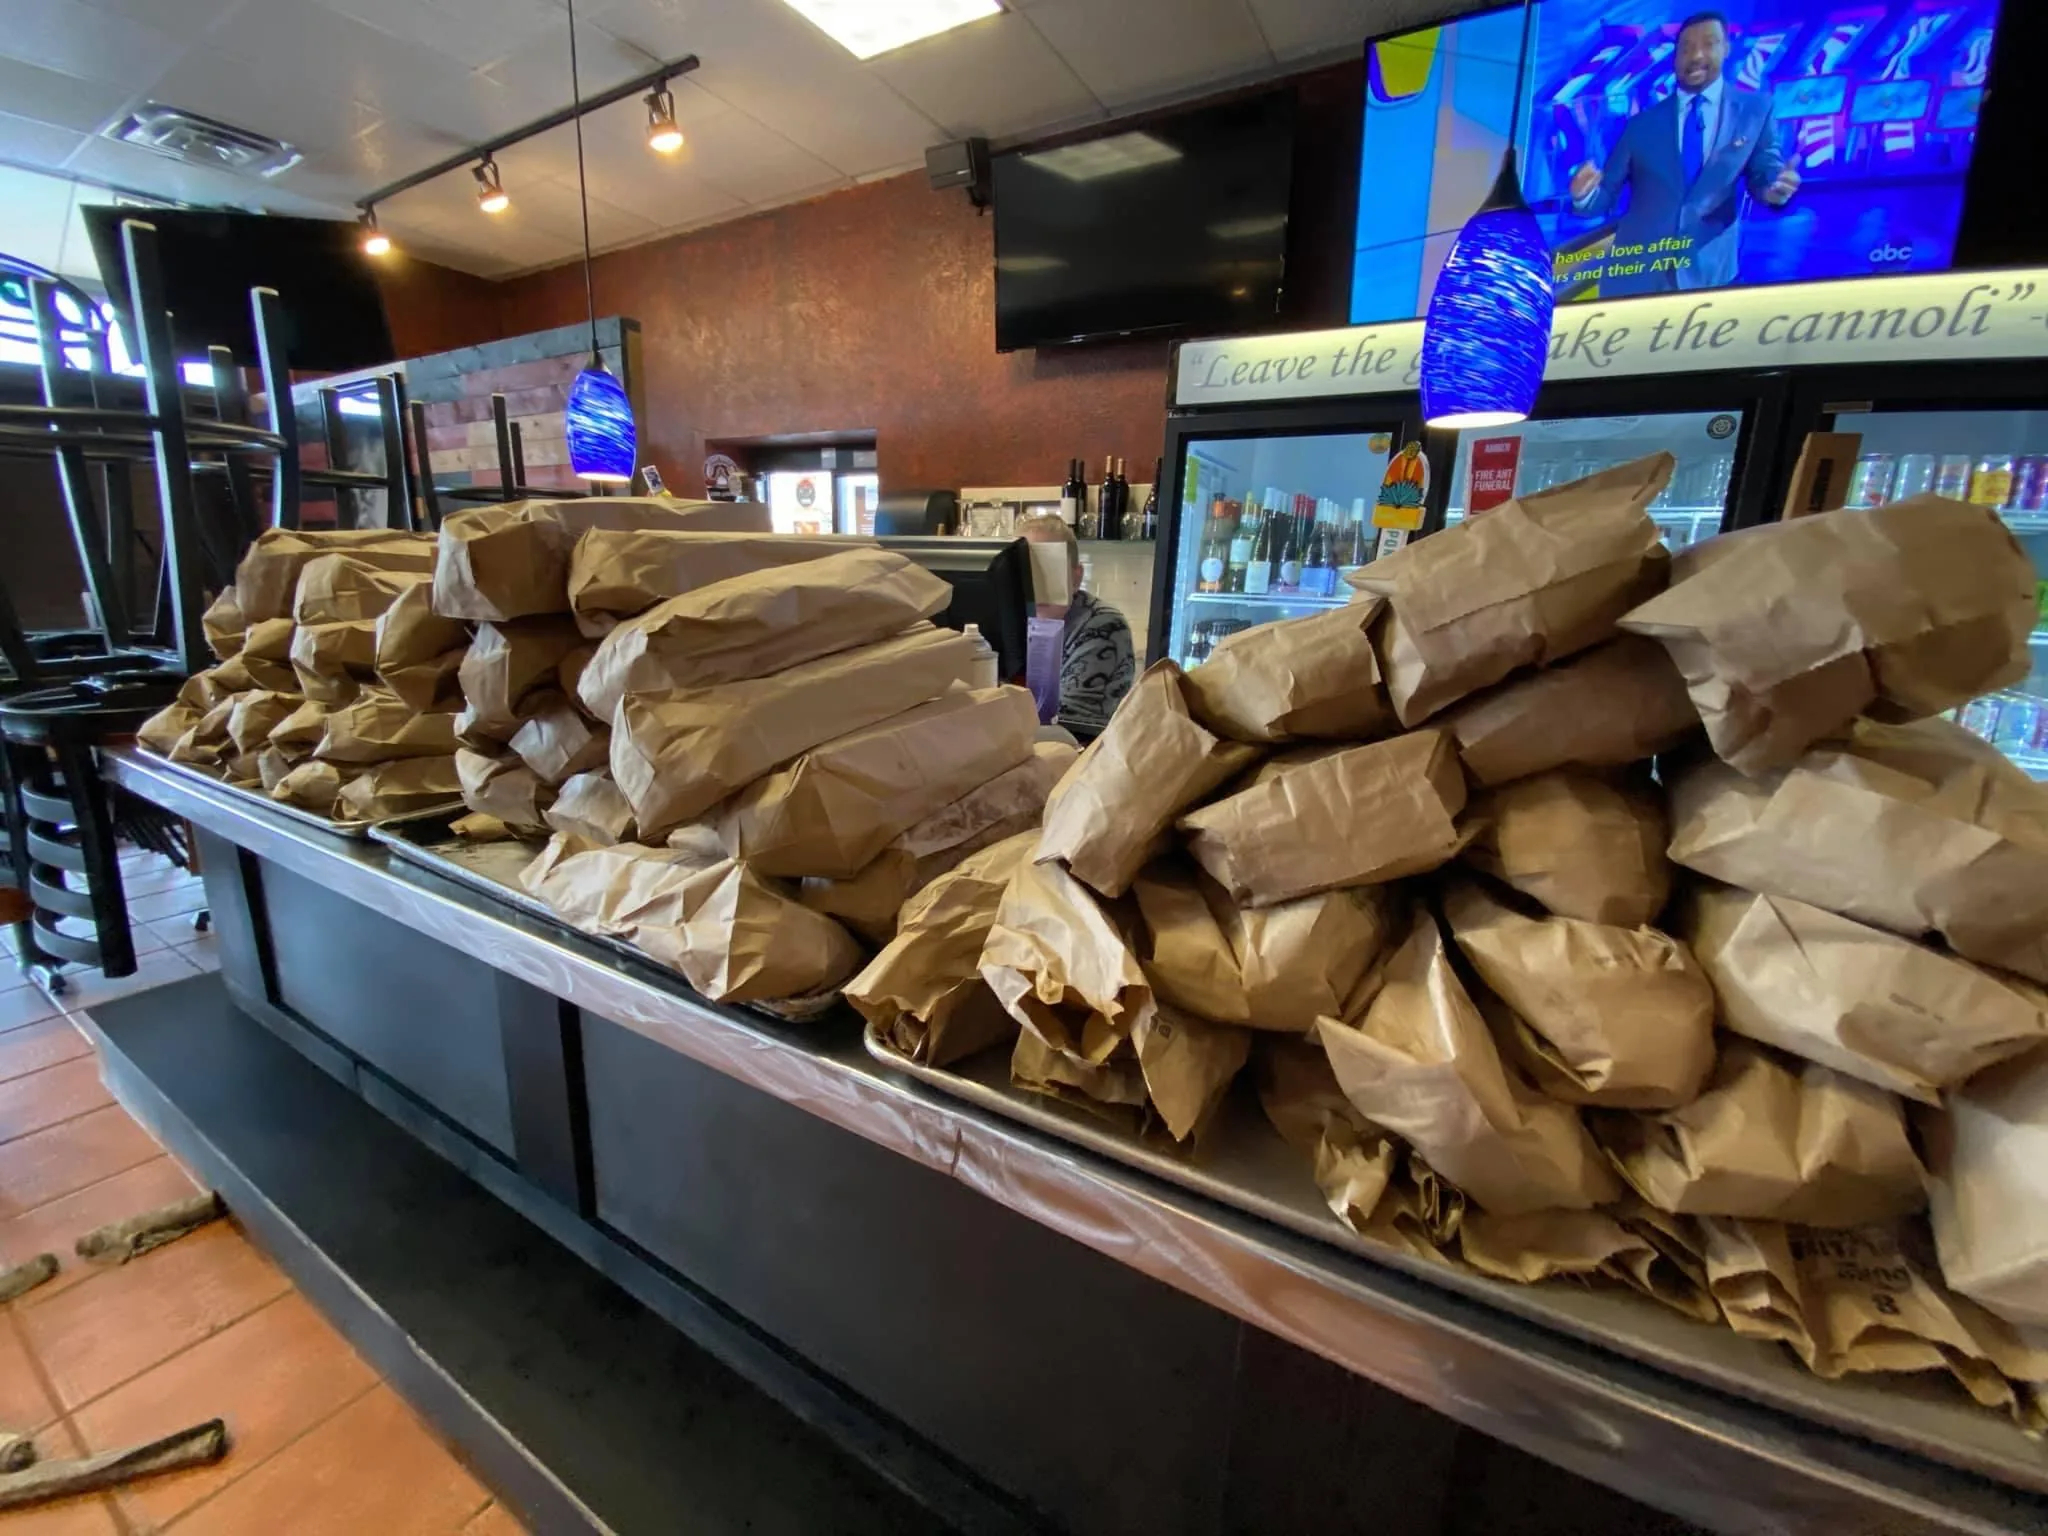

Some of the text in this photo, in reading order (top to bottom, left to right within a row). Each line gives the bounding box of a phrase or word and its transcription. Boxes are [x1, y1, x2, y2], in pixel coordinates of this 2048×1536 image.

[1555, 236, 1694, 265] have a love affair
[1869, 244, 1913, 262] abc
[1573, 267, 1603, 281] and
[1608, 262, 1646, 277] their
[1650, 256, 1692, 272] ATVs
[1331, 334, 1397, 378] the
[1650, 303, 1739, 352] the
[1475, 469, 1513, 481] FIRE ANT
[1474, 480, 1512, 492] FUNERAL
